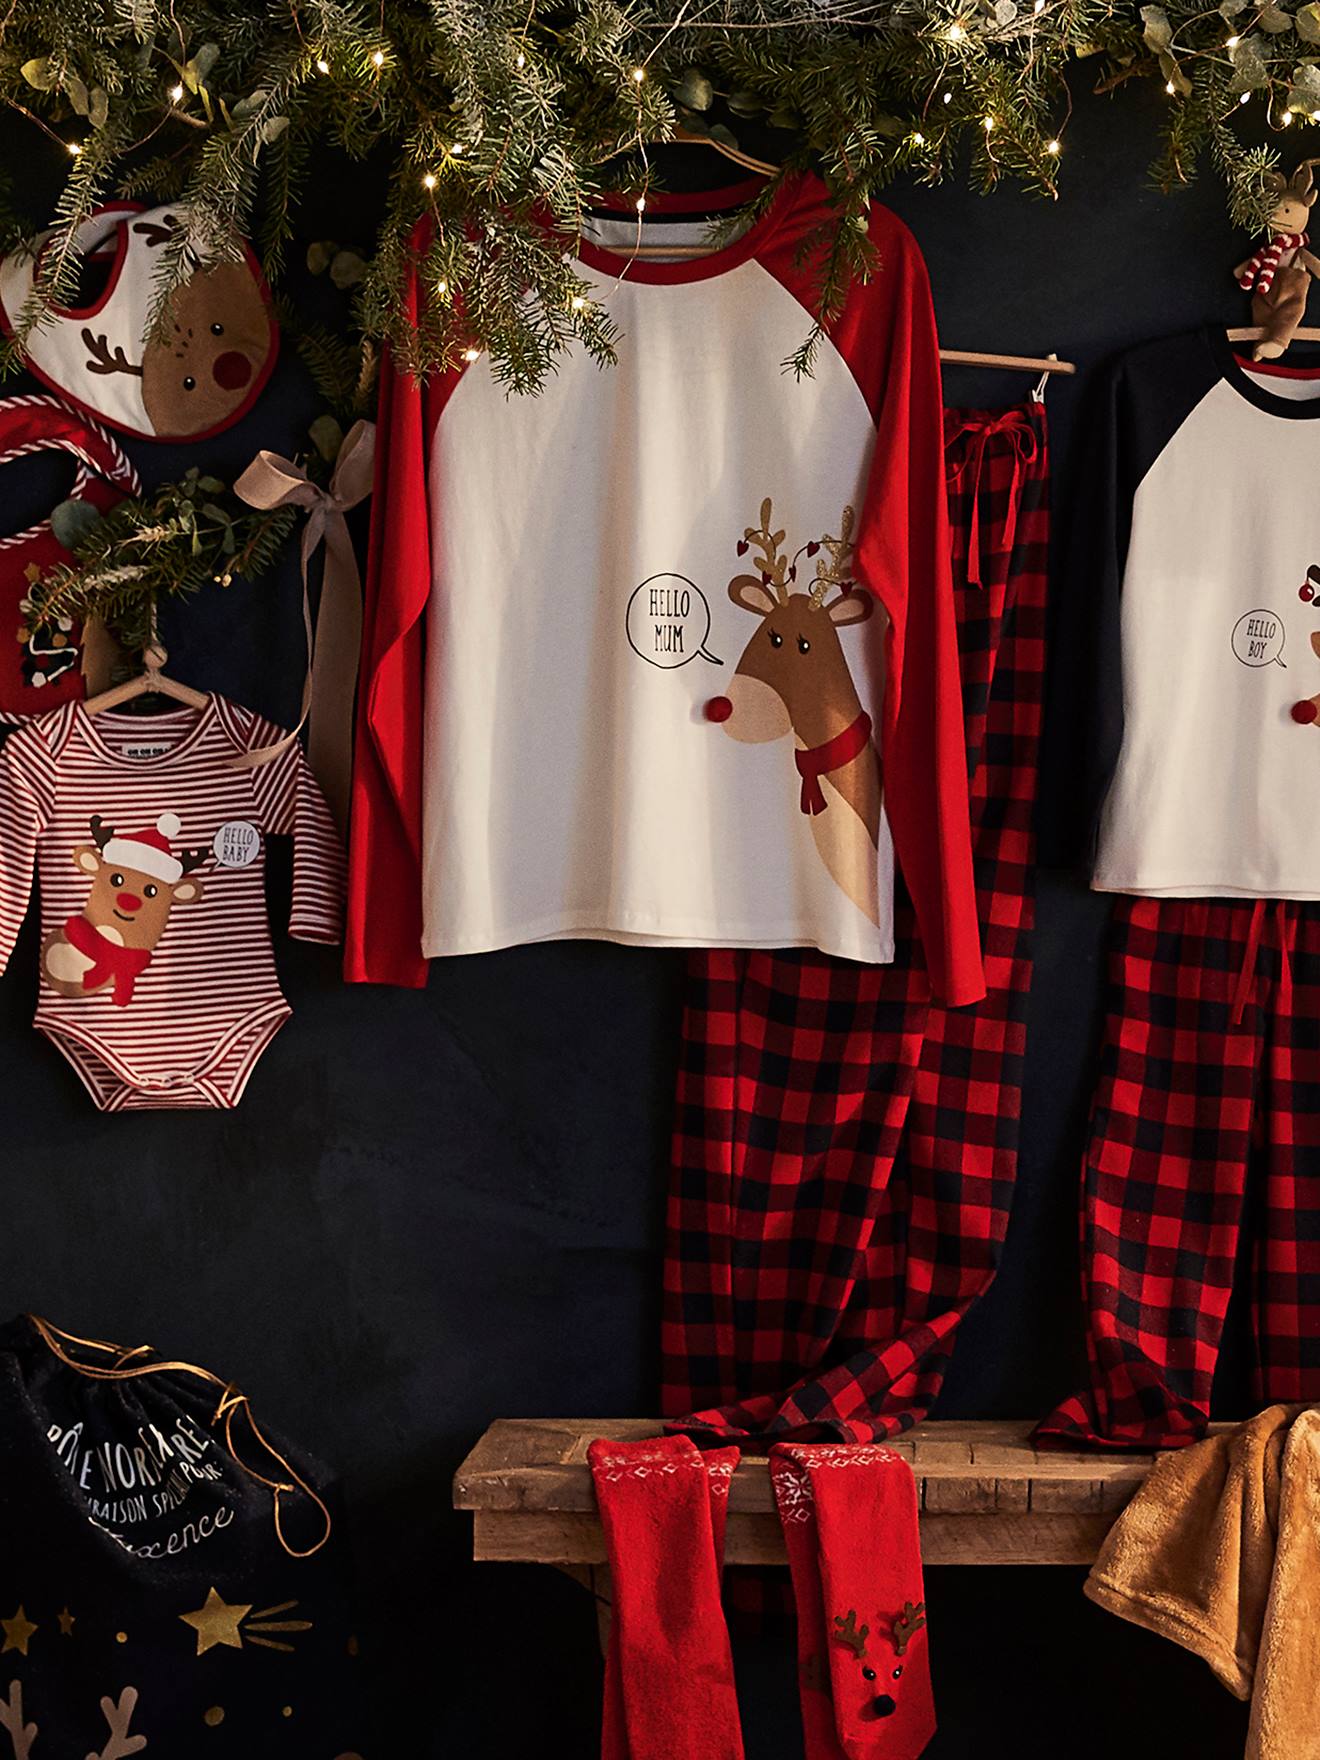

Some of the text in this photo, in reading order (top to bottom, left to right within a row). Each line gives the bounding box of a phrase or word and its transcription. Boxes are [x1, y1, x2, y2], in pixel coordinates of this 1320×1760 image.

[649, 589, 690, 617] HELLO
[654, 624, 684, 653] MUM
[1246, 619, 1276, 639] HELLO
[1248, 640, 1268, 659] BOY
[223, 827, 254, 845] HELLO
[223, 844, 250, 862] BABY
